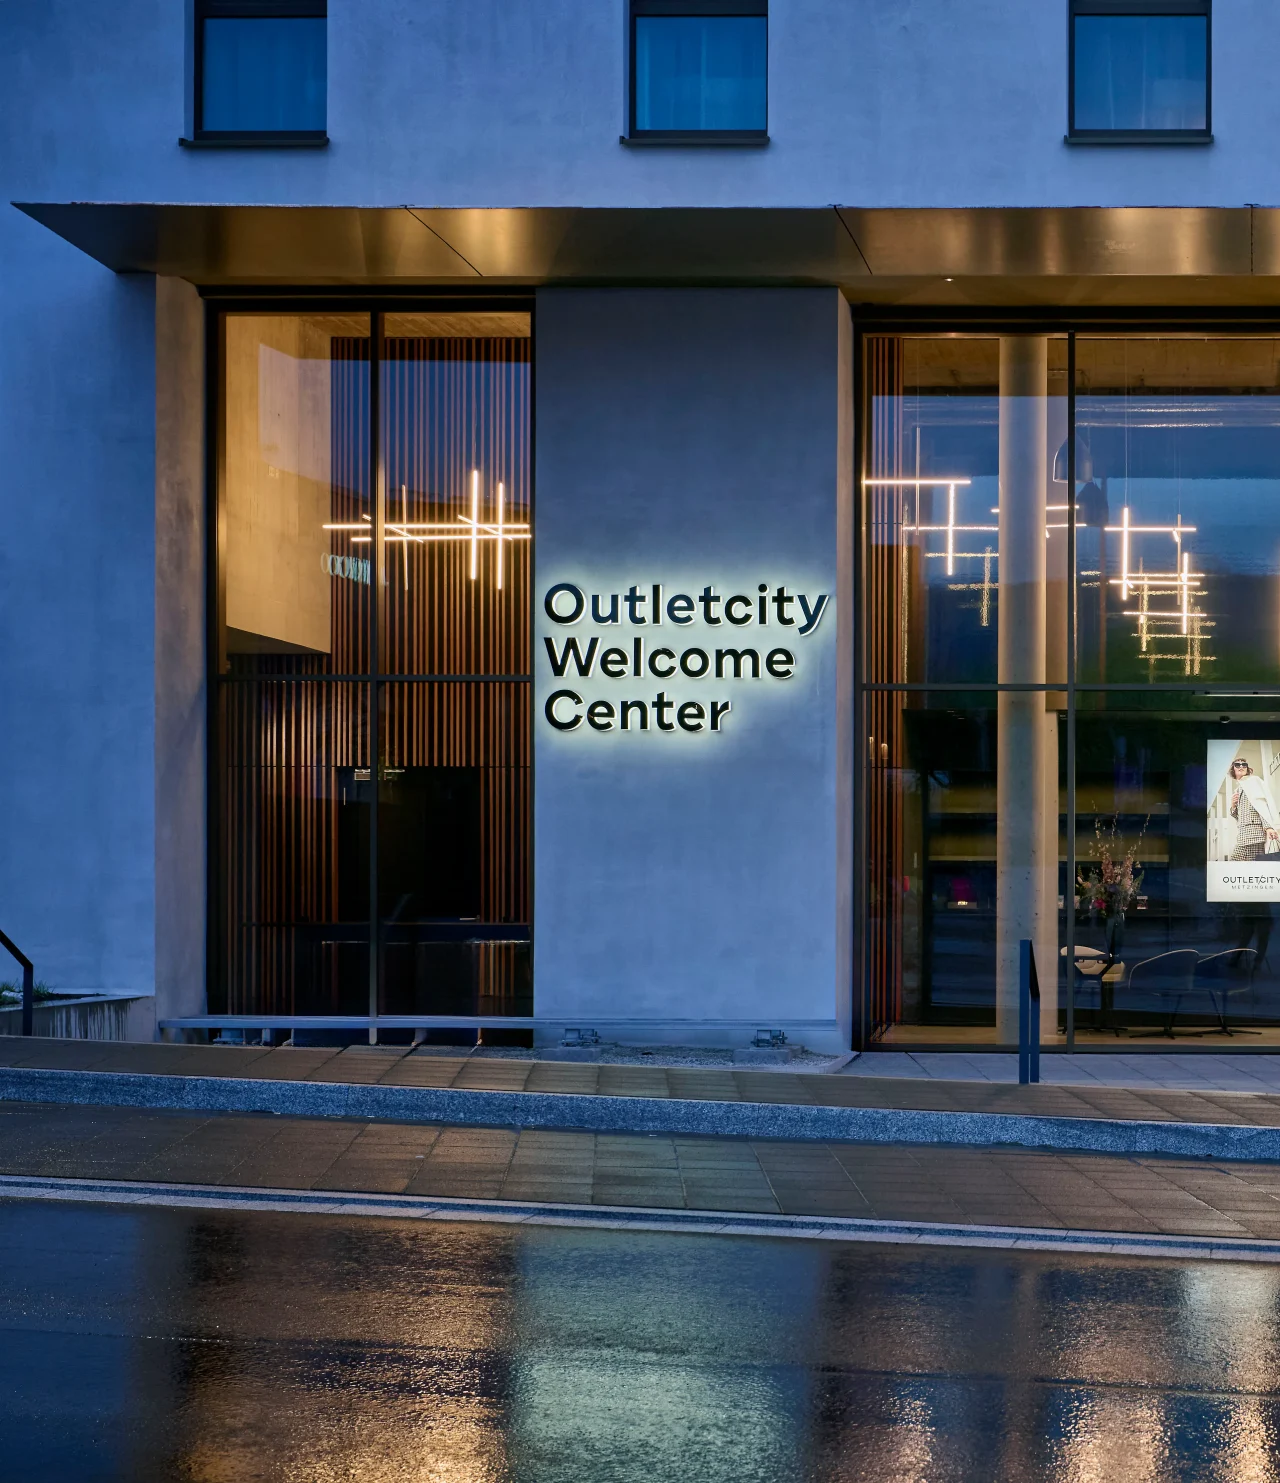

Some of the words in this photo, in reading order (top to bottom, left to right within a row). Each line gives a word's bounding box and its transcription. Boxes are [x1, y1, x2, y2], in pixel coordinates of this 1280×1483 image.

[544, 583, 829, 636] Outletcity
[543, 636, 796, 679] Welcome
[544, 689, 732, 732] Center
